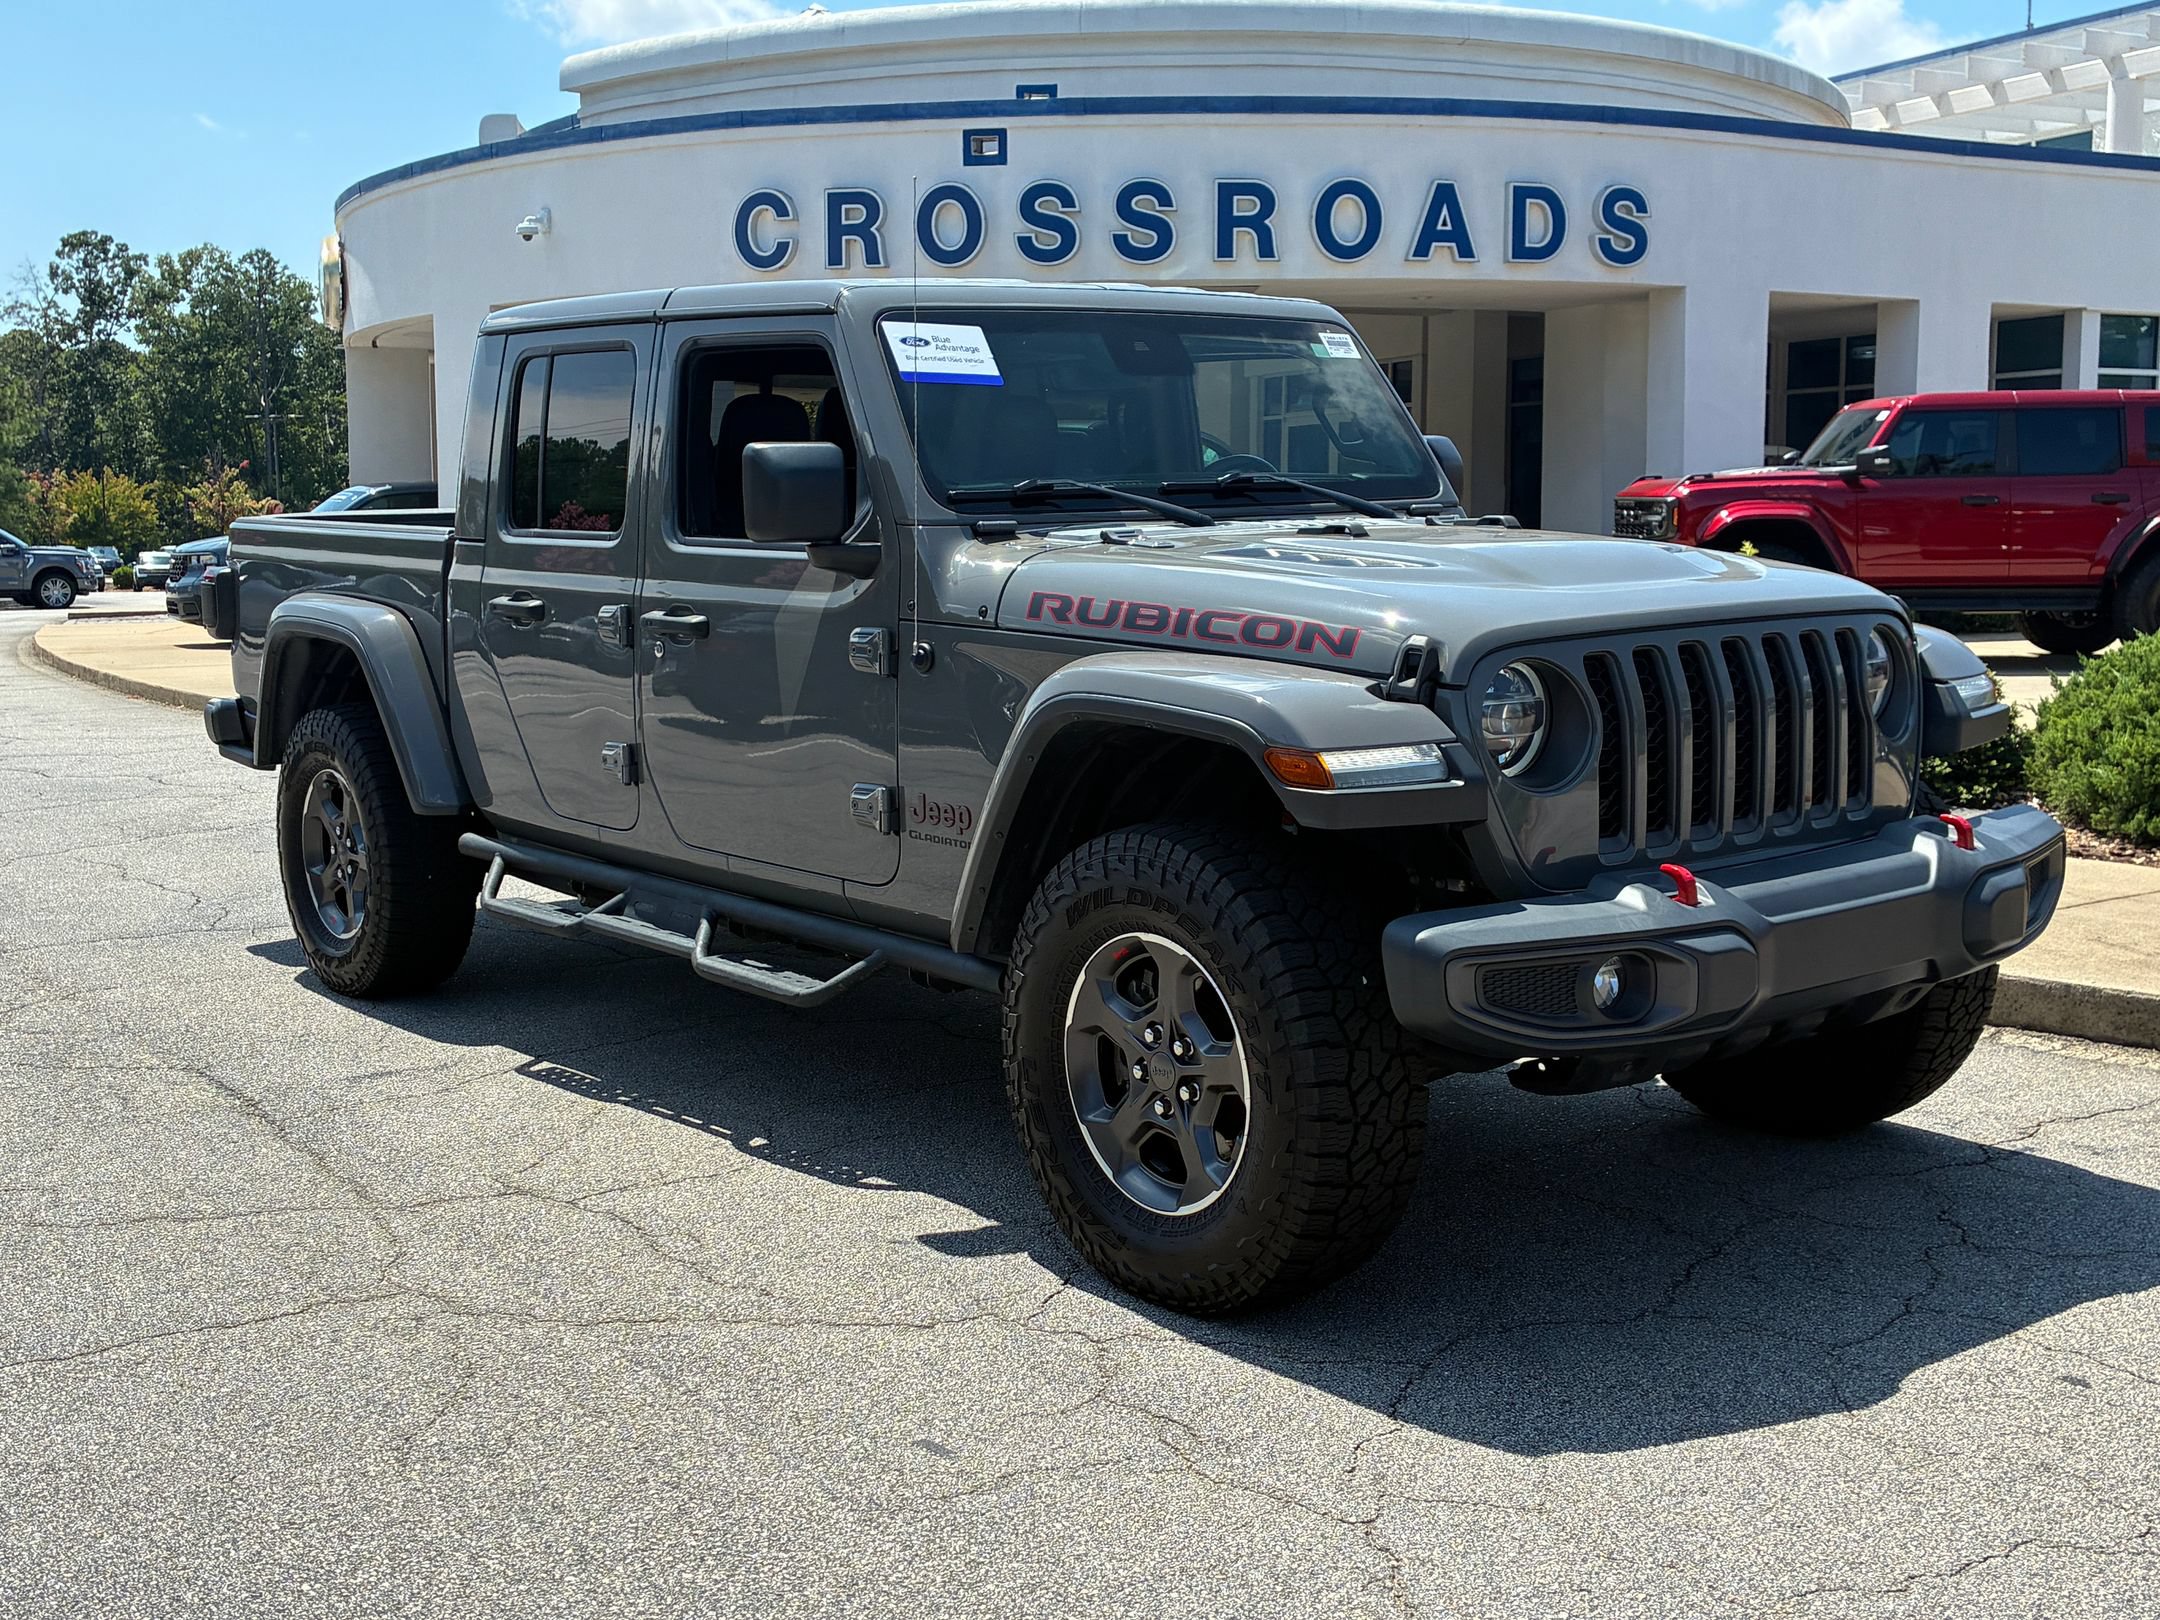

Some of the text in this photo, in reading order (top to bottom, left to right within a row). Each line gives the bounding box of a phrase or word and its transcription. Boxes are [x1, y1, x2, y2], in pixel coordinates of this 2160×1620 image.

[733, 179, 1652, 271] CROSSROADS
[931, 335, 951, 344] Blue
[935, 344, 981, 354] Advantage
[1025, 591, 1362, 659] RUBICON
[909, 792, 972, 835] Jeep
